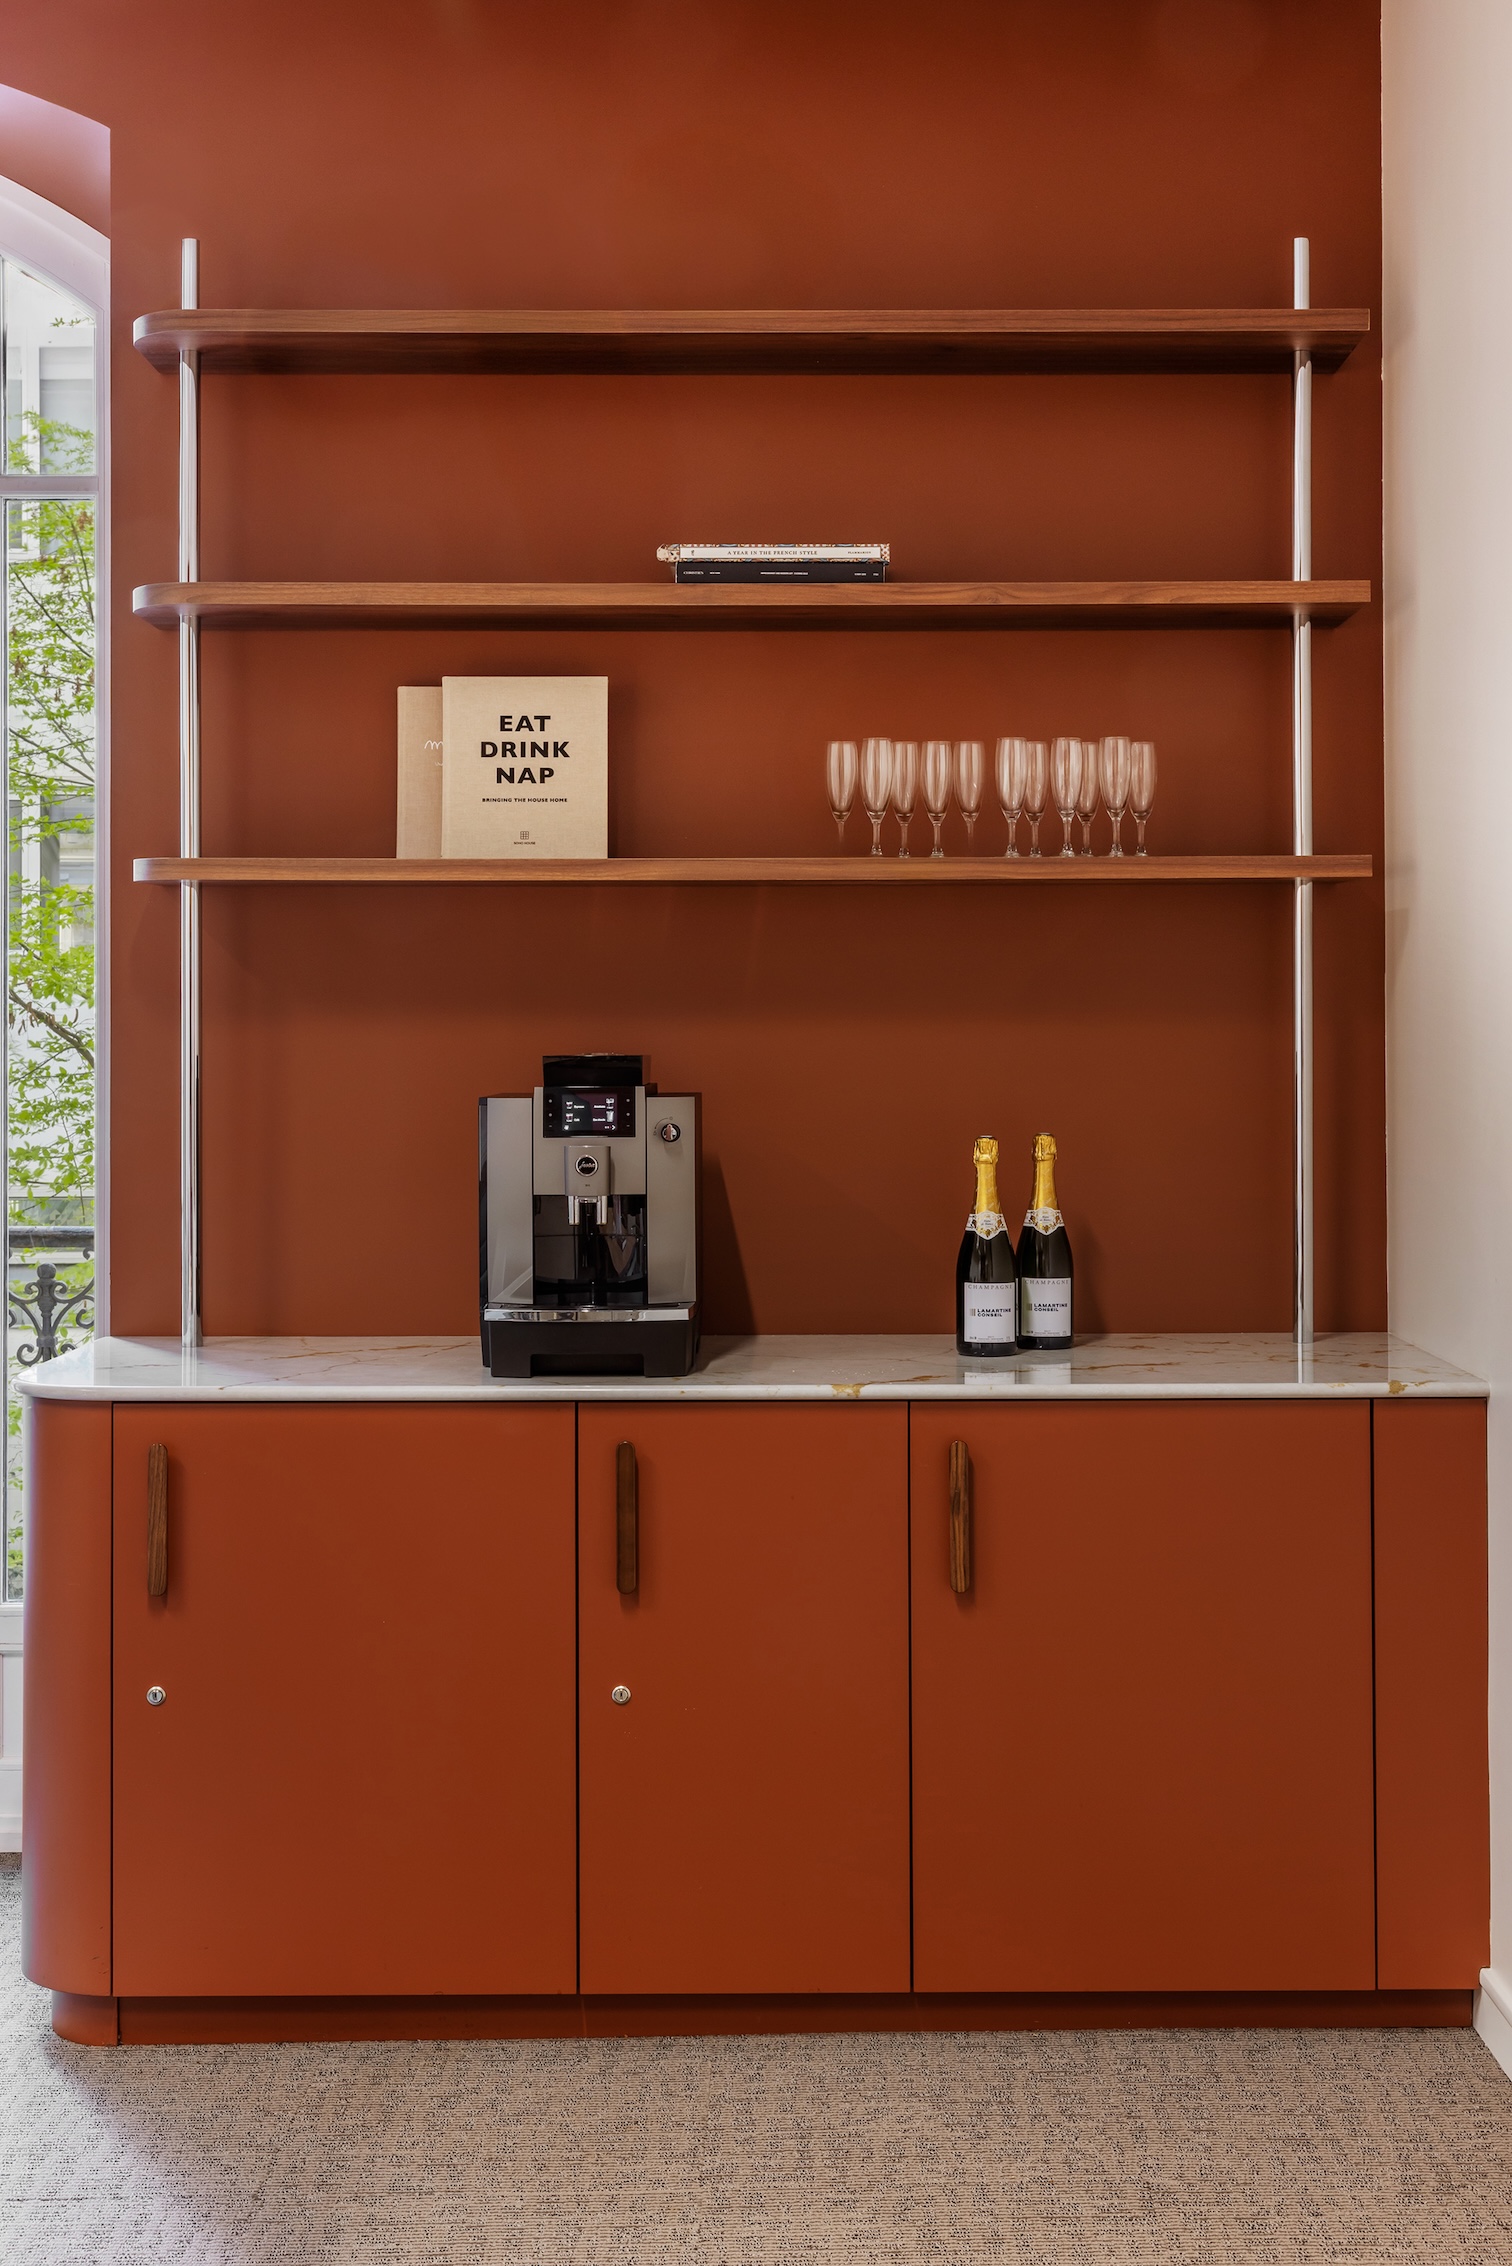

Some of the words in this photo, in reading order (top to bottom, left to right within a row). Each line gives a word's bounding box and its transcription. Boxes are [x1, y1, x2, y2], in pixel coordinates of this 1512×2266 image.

[500, 716, 551, 731] EAT
[481, 742, 570, 758] DRINK
[497, 768, 554, 783] NAP
